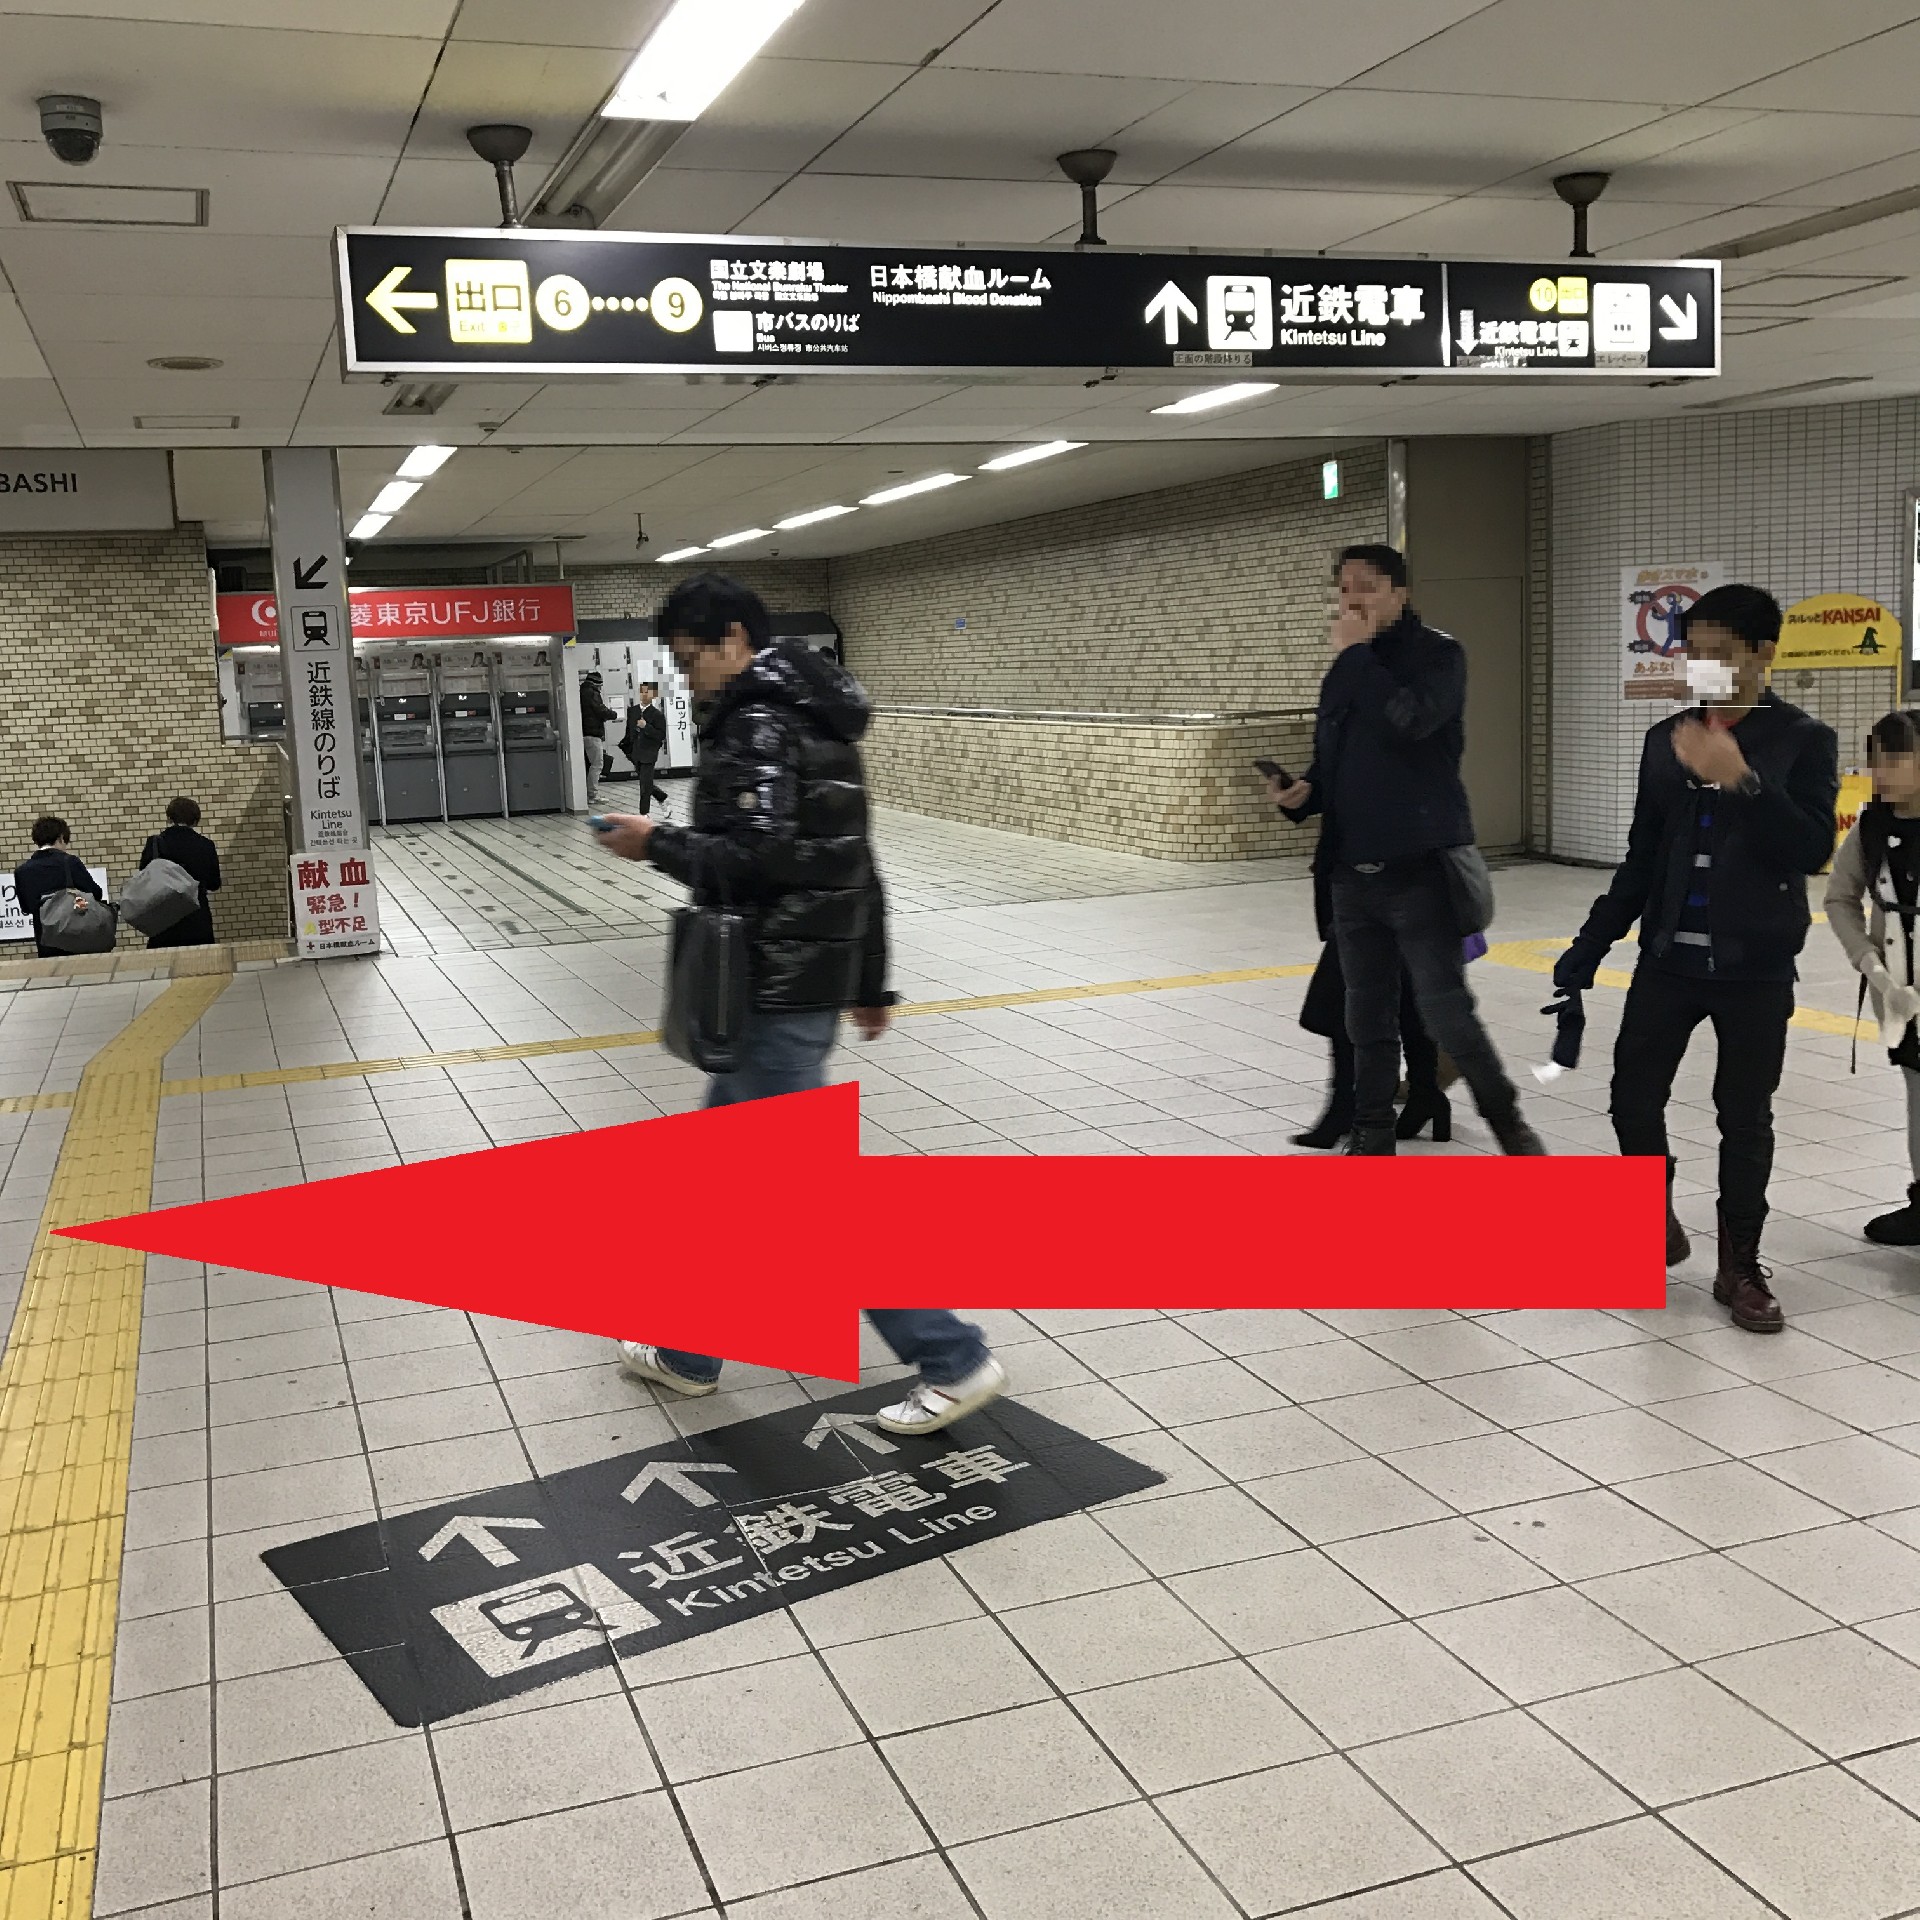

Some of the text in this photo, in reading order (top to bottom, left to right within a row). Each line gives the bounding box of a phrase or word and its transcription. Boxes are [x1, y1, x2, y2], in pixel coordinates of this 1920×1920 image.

[870, 264, 1051, 290] 日本橋献血ルーム
[455, 281, 523, 312] 出口
[554, 289, 572, 317] 6
[668, 291, 686, 319] 9
[873, 291, 1042, 306] Nippombashi Blood Donation
[1280, 284, 1425, 326] 近鉄電車
[1535, 287, 1553, 302] 10
[459, 321, 486, 332] Exit
[756, 311, 860, 333] 市バスのりば
[756, 332, 775, 342] Bus
[1281, 328, 1386, 346] Kintetsu Line
[1495, 345, 1558, 357] Kintetsu Line
[307, 661, 341, 799] 近鉄線のりば
[675, 696, 687, 741] ロッカー
[310, 809, 352, 820] Kintetsu
[322, 820, 343, 830] Line
[296, 857, 370, 890] 献血
[306, 893, 359, 914] 緊急！
[617, 1444, 1031, 1590] 近鉄電車
[666, 1503, 997, 1617] Kintetsu Line
